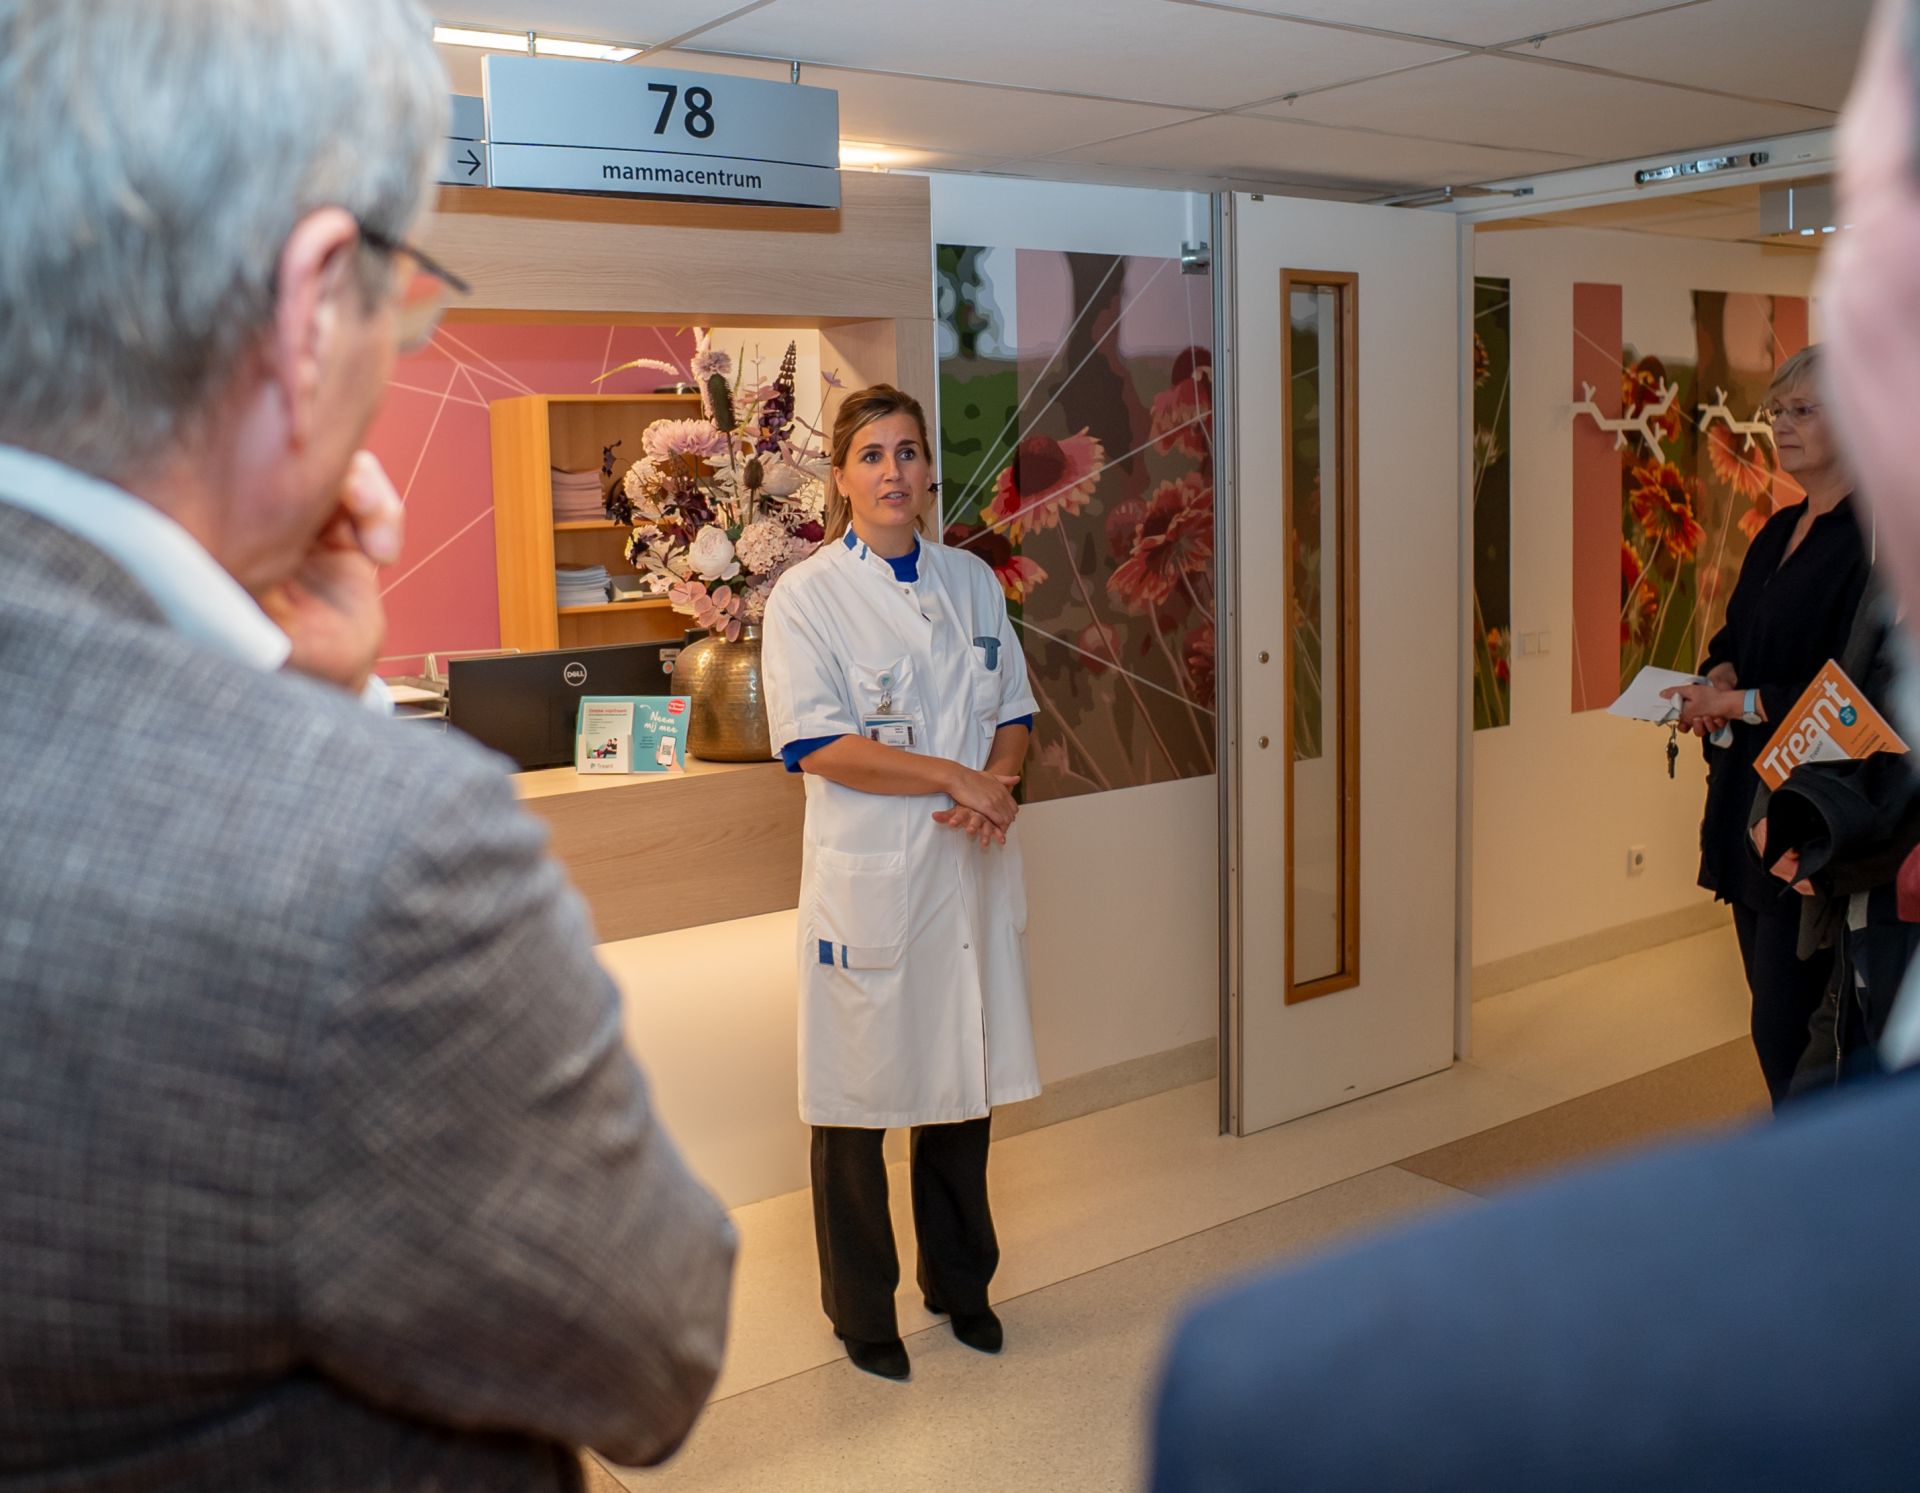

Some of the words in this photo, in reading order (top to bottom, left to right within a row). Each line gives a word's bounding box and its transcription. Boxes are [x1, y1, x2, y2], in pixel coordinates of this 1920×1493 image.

[647, 82, 715, 139] 78
[602, 163, 762, 190] mammacentrum
[1762, 680, 1851, 781] Treant
